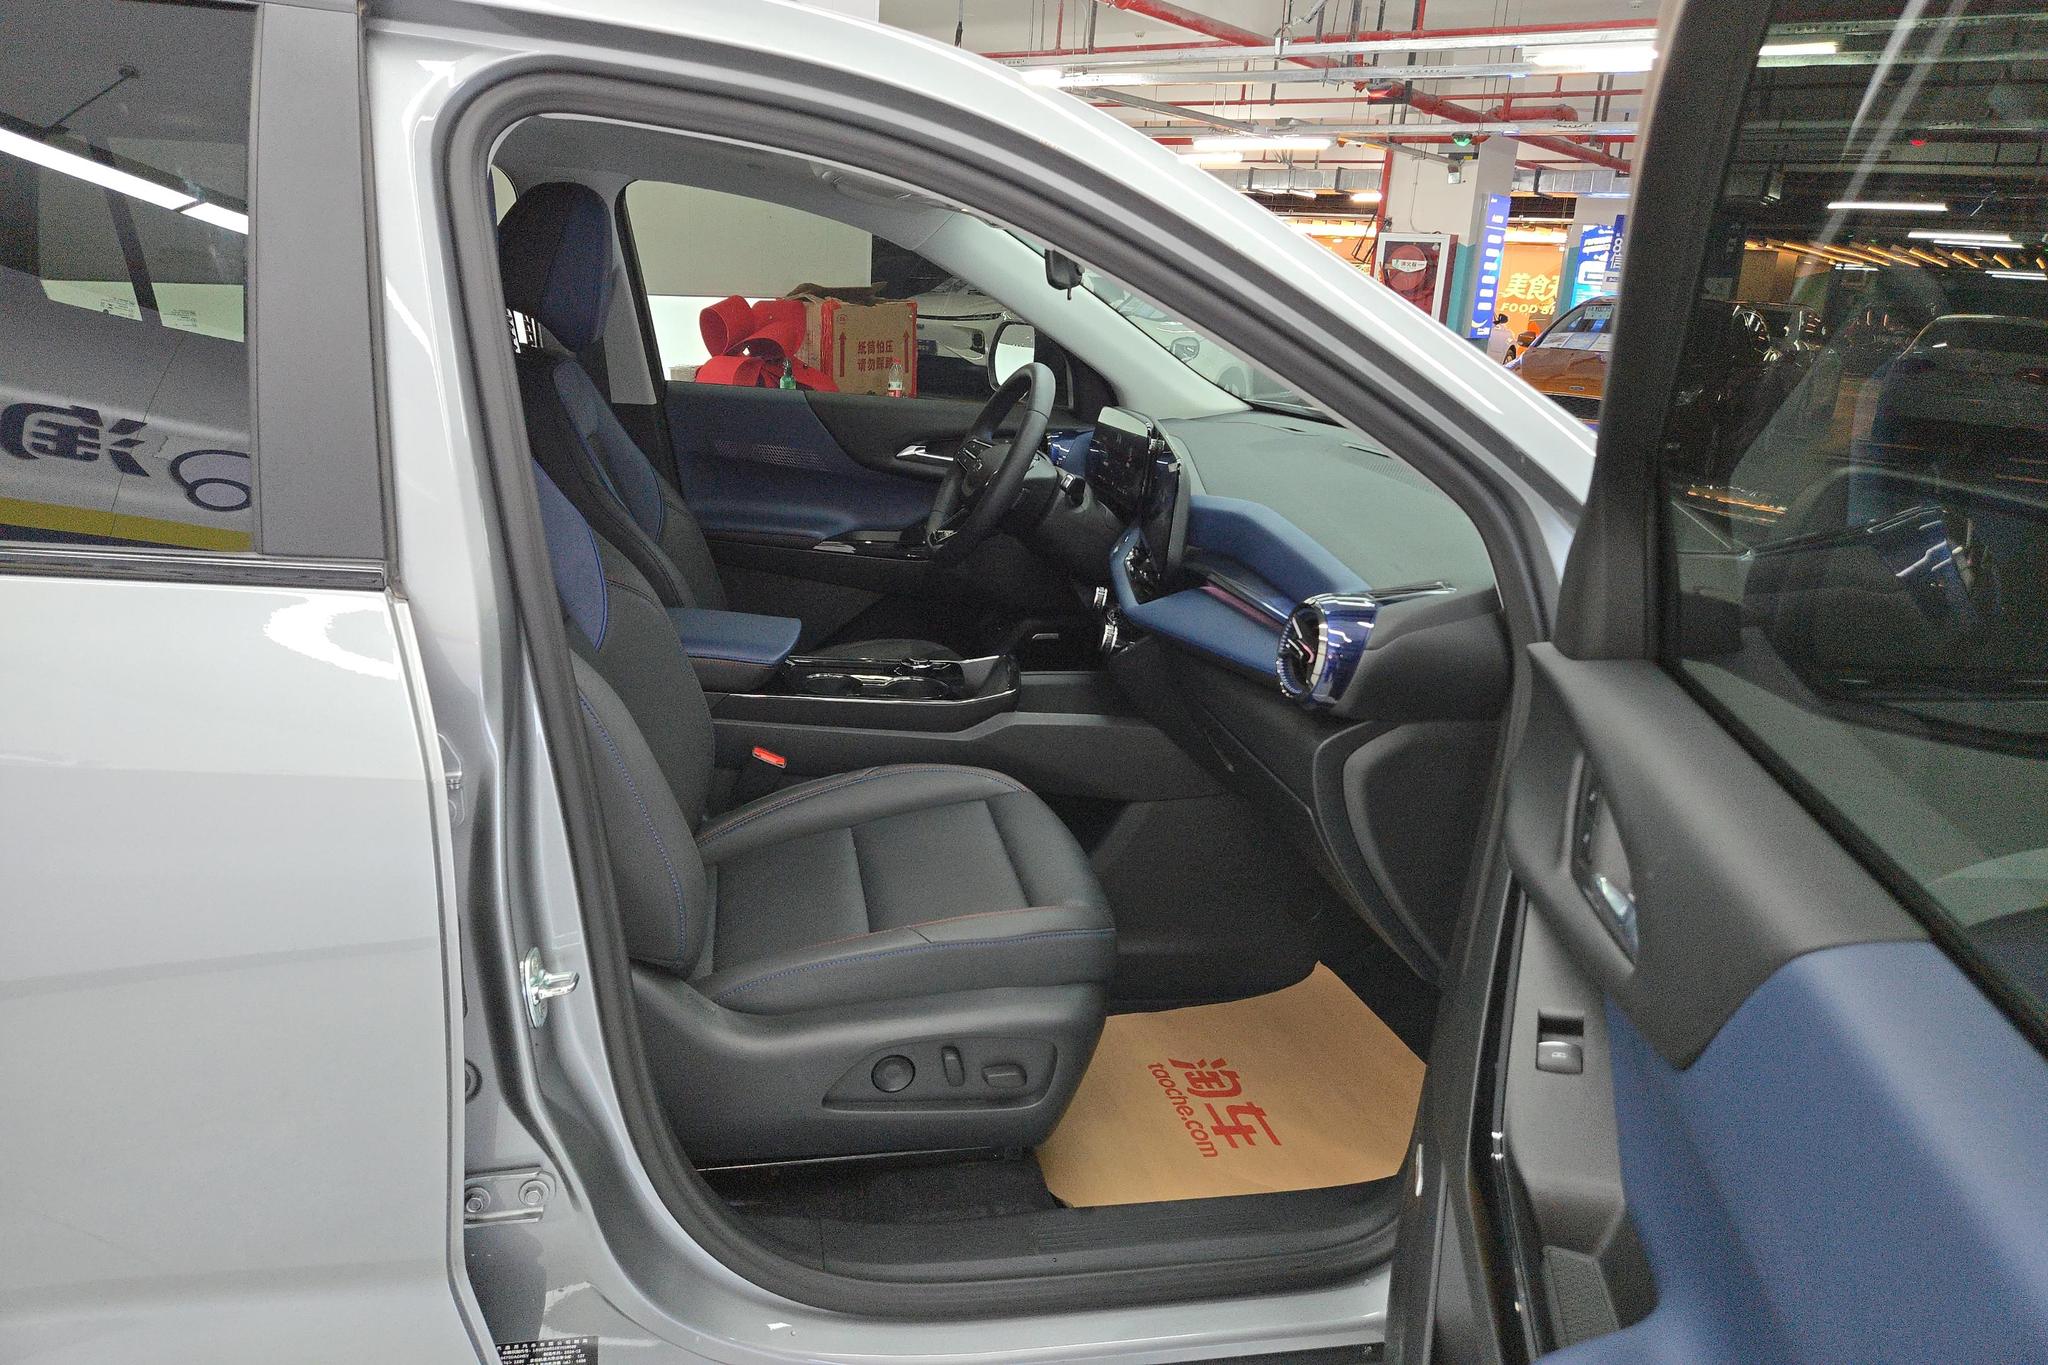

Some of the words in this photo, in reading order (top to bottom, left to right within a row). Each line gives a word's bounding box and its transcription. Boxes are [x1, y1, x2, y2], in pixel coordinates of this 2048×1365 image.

[1500, 302, 1538, 314] FOOD
[857, 340, 894, 354] 纸筒怕压
[1147, 1062, 1218, 1157] taoche.com
[1168, 1058, 1281, 1149] 淘车
